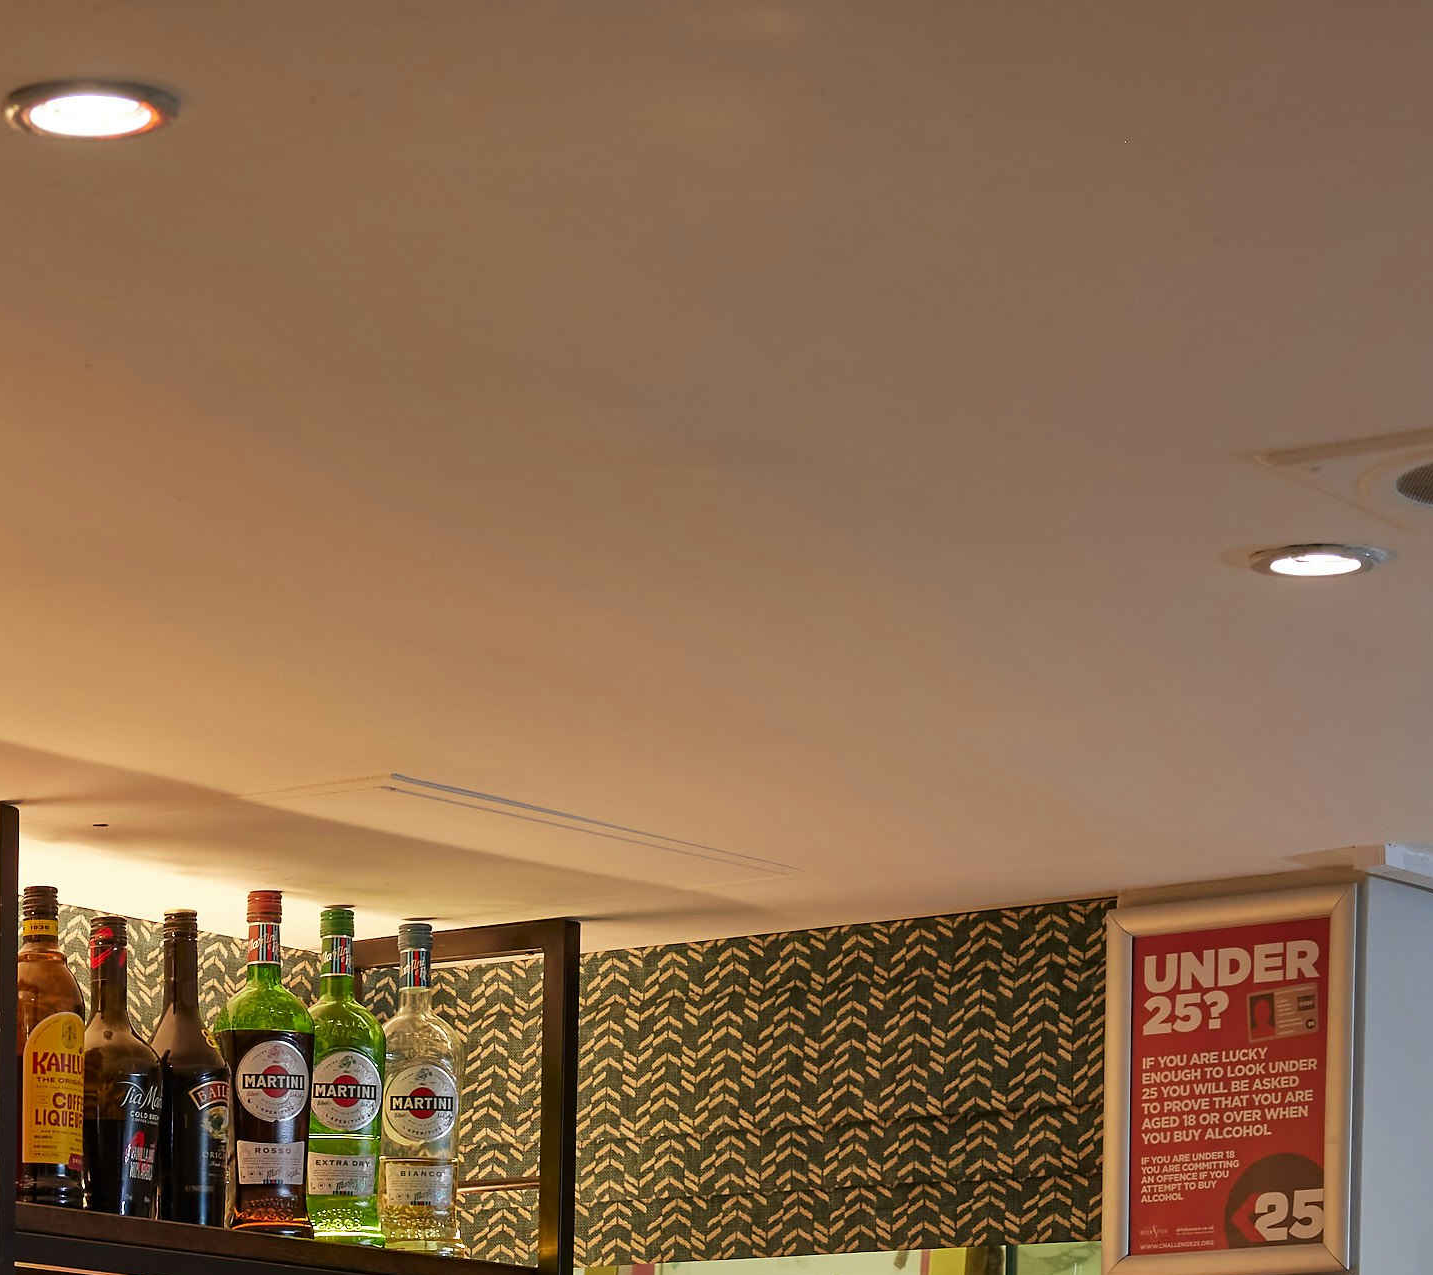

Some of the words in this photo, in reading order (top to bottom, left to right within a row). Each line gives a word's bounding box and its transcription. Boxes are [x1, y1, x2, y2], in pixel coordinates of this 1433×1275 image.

[1143, 939, 1320, 995] UNDER
[1143, 990, 1230, 1036] 25?
[1142, 1057, 1155, 1069] IF
[1158, 1054, 1187, 1069] YOU
[1190, 1051, 1219, 1066] ARE
[1222, 1047, 1268, 1064] LUCKY
[1142, 1068, 1200, 1085] ENOUGH
[1204, 1066, 1222, 1080] TO
[1227, 1062, 1266, 1078] LOOK
[1269, 1058, 1318, 1074] UNDER
[243, 1074, 304, 1090] MARTINI
[1142, 1087, 1158, 1100] 25
[1161, 1084, 1190, 1099] YOU
[1193, 1081, 1228, 1096] WILL
[1231, 1079, 1249, 1093] BE
[1252, 1075, 1300, 1092] ASKED
[314, 1083, 376, 1100] MARTINI
[390, 1096, 453, 1112] MARTINI
[1142, 1102, 1160, 1115] TO
[1164, 1098, 1209, 1114] PROVE
[1213, 1095, 1249, 1110] THAT
[1252, 1092, 1282, 1107] YOU
[1285, 1089, 1313, 1105] ARE
[130, 1110, 146, 1119] COLD
[1141, 1115, 1180, 1130] AGED
[1183, 1114, 1196, 1127] 18
[1199, 1113, 1220, 1126] OR
[1223, 1110, 1261, 1125] OVER
[1264, 1105, 1309, 1122] WHEN
[1141, 1131, 1171, 1146] YOU
[1173, 1129, 1202, 1144] BUY
[1205, 1123, 1272, 1142] ALCOHOL
[254, 1147, 292, 1155] ROSSO
[1141, 1156, 1150, 1165] IF
[1151, 1154, 1170, 1165] YOU
[1172, 1153, 1191, 1163] ARE
[1192, 1150, 1222, 1162] UNDER
[1225, 1150, 1235, 1159] 18
[315, 1159, 349, 1168] EXTRA
[352, 1160, 372, 1168] DRY
[1141, 1164, 1160, 1175] YOU
[1162, 1163, 1181, 1173] ARE
[1182, 1159, 1240, 1172] COMMITTING
[400, 1170, 443, 1178] BIANCO
[1141, 1175, 1154, 1184] AN
[1156, 1172, 1197, 1183] OFFENCE
[1199, 1171, 1207, 1180] IF
[1209, 1170, 1230, 1180] YOU
[1141, 1183, 1182, 1194] ATTEMPT
[1184, 1181, 1197, 1190] TO
[1198, 1180, 1218, 1190] BUY
[1141, 1192, 1184, 1203] ALCOHOL
[1254, 1188, 1324, 1242] 25
[1140, 1239, 1215, 1250] WWW.CHALLENGE25.ORG
